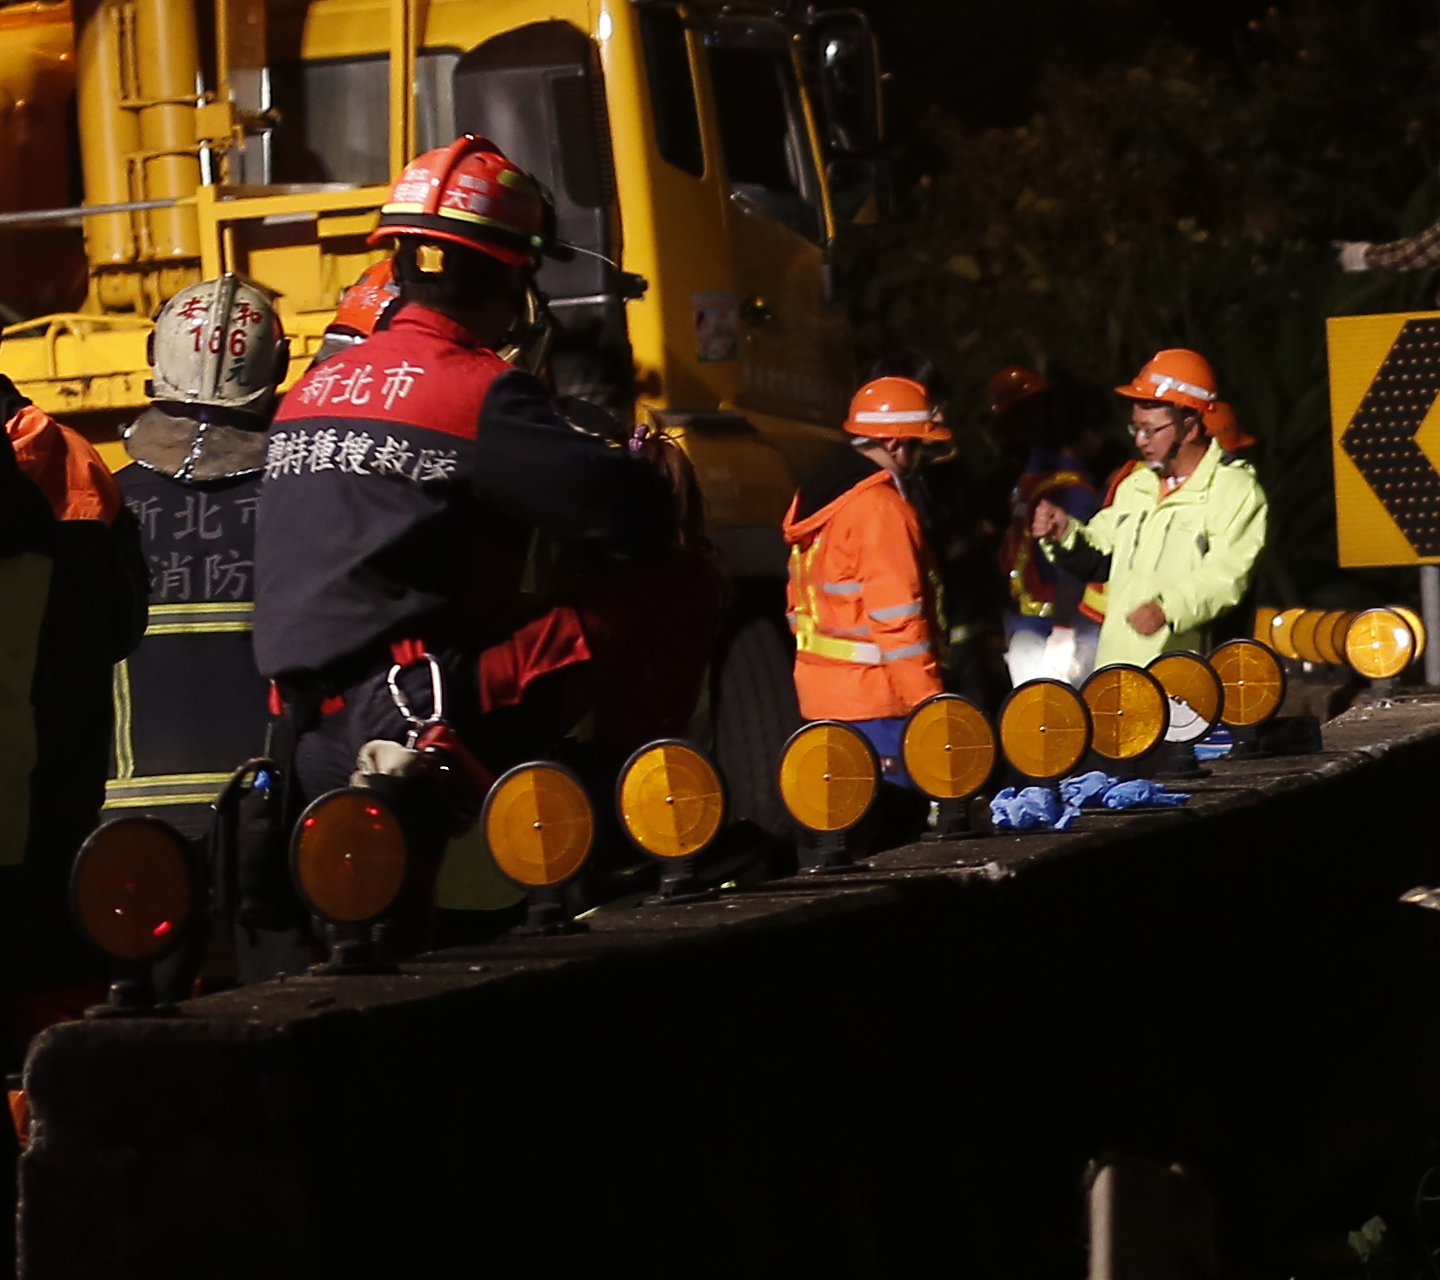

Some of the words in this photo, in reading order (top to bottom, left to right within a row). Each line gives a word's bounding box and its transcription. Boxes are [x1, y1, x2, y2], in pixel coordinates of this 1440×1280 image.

[298, 361, 426, 410] 新北市
[148, 549, 254, 600] 消防
